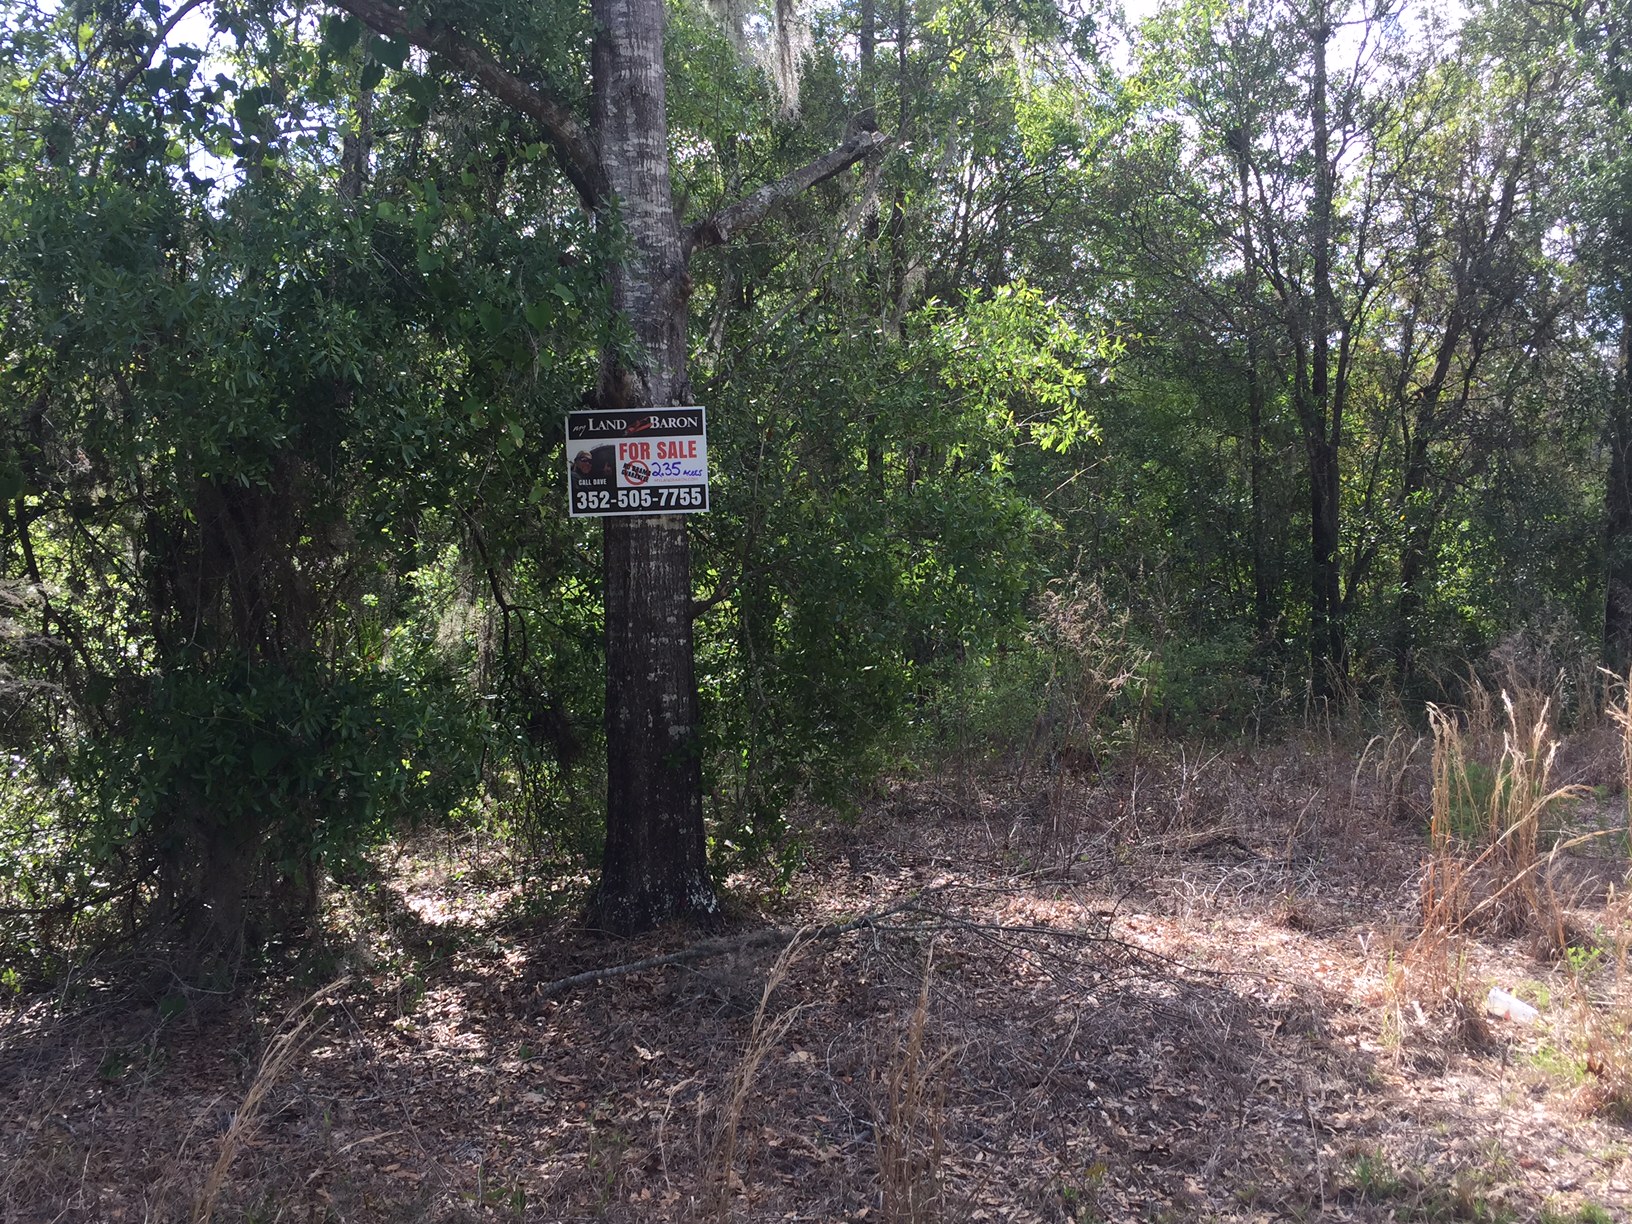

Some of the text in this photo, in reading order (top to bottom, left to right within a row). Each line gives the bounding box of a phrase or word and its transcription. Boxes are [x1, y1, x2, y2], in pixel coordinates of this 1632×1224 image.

[588, 418, 627, 431] LAND
[649, 416, 698, 429] BARON
[619, 440, 697, 460] FOR SALE
[651, 461, 682, 478] 2.35
[593, 478, 607, 486] DAVE
[576, 487, 702, 509] 352-505-7755
